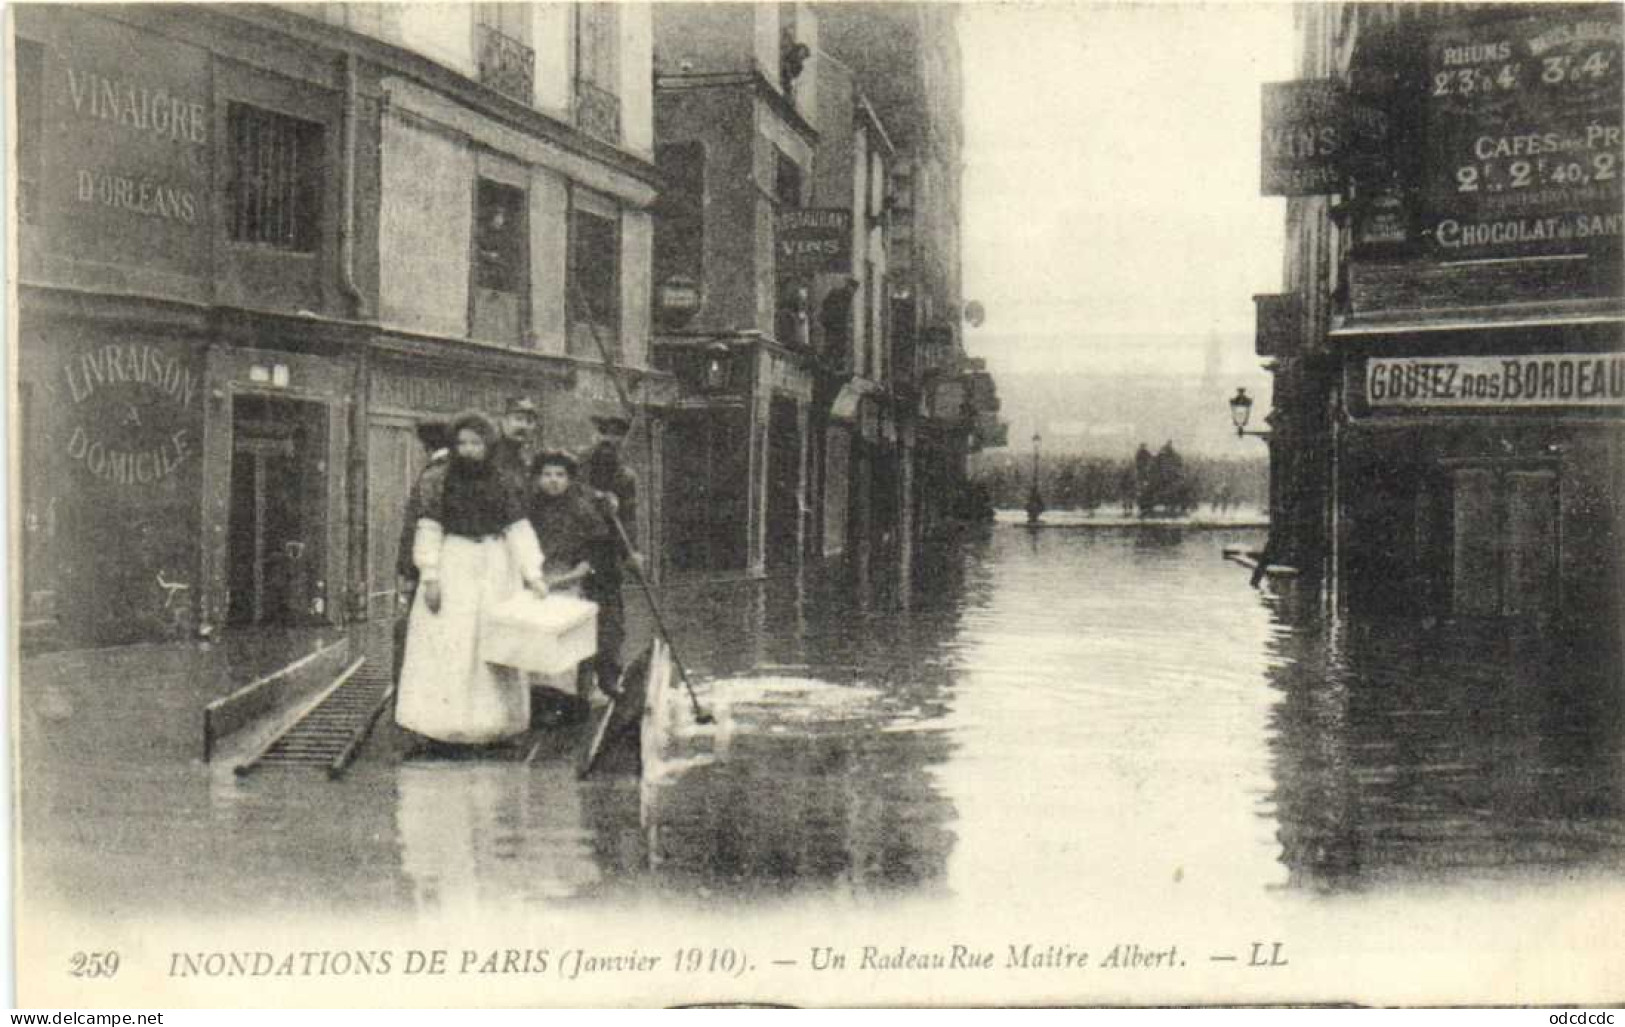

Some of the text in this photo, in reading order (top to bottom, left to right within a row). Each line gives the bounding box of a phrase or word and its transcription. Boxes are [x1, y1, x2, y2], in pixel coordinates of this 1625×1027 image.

[1443, 40, 1512, 66] RHUMS
[66, 67, 208, 144] VINAIGRE
[1265, 125, 1337, 158] VINS
[1436, 219, 1557, 248] CHOCOLAT
[64, 342, 196, 410] LIVRAISON
[66, 425, 193, 485] DOMICILE
